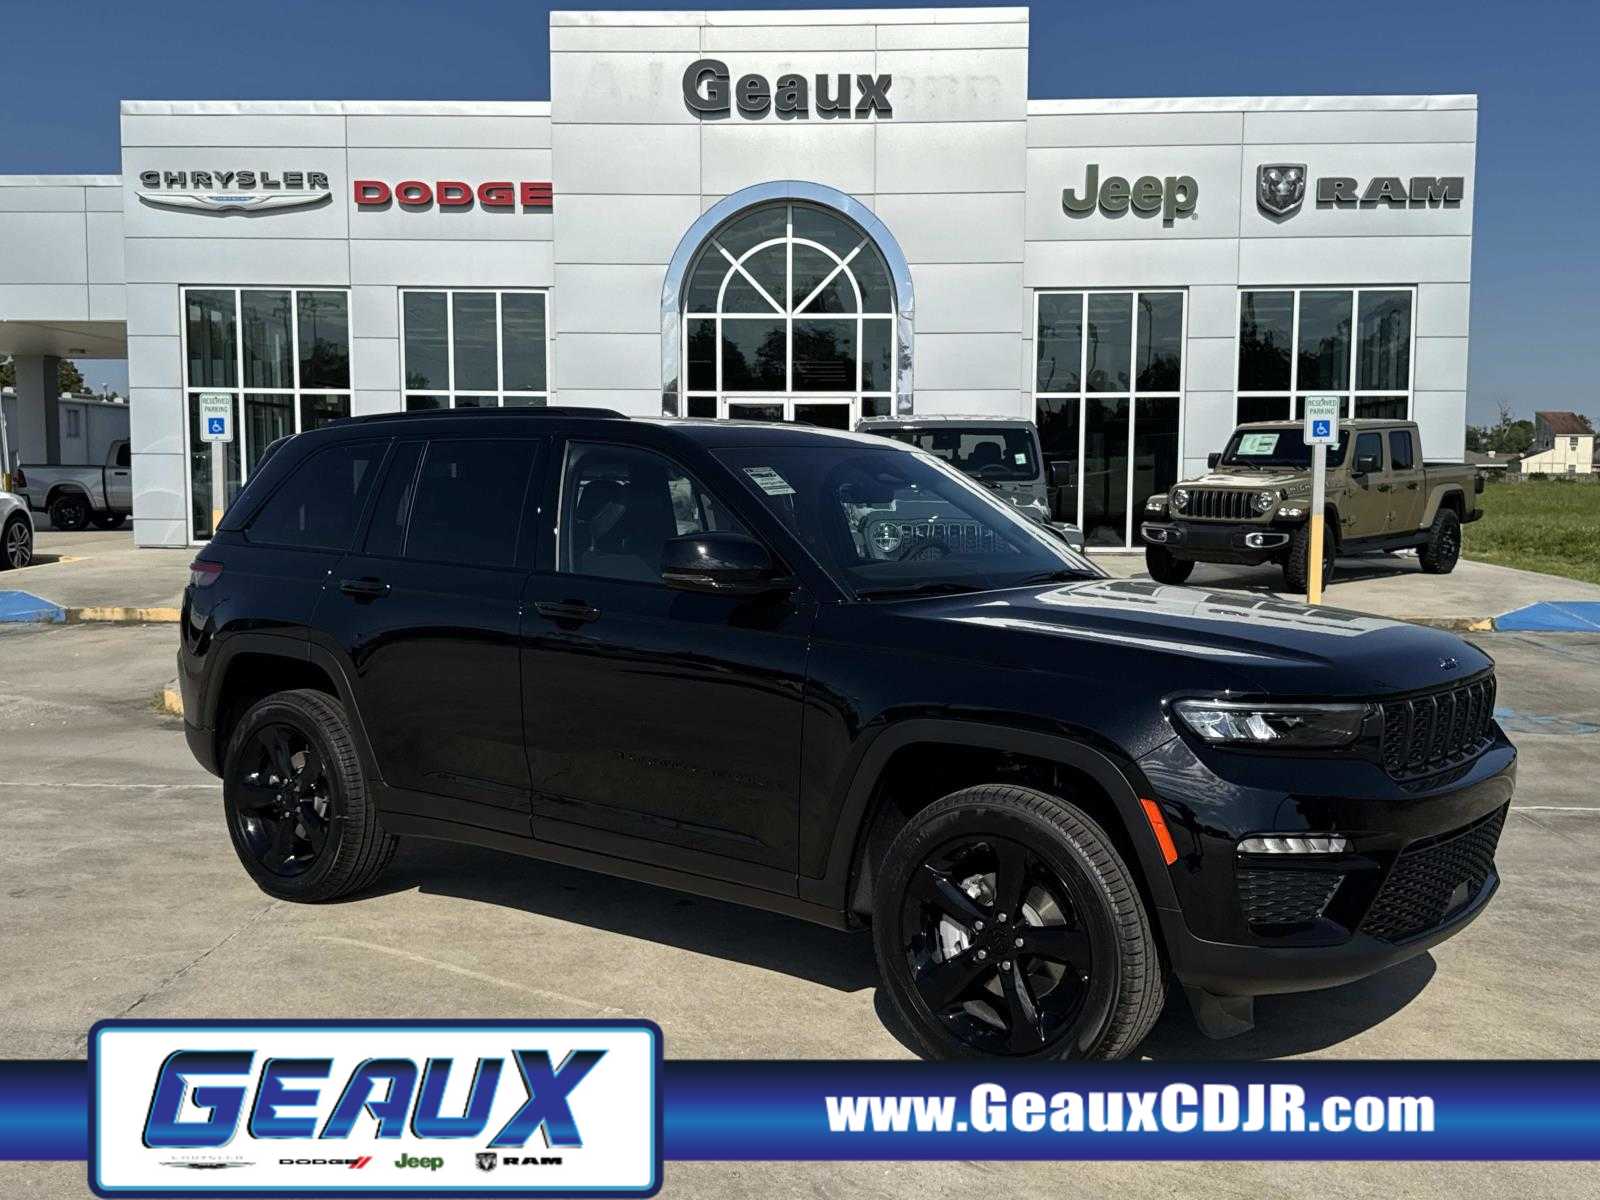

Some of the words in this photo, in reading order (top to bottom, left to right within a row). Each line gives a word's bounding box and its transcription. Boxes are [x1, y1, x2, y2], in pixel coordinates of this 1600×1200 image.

[682, 58, 893, 120] Geaux
[139, 169, 330, 190] CHRYSLER
[353, 179, 553, 212] DODGE
[1062, 163, 1199, 228] Jeep
[1316, 176, 1465, 209] RAM
